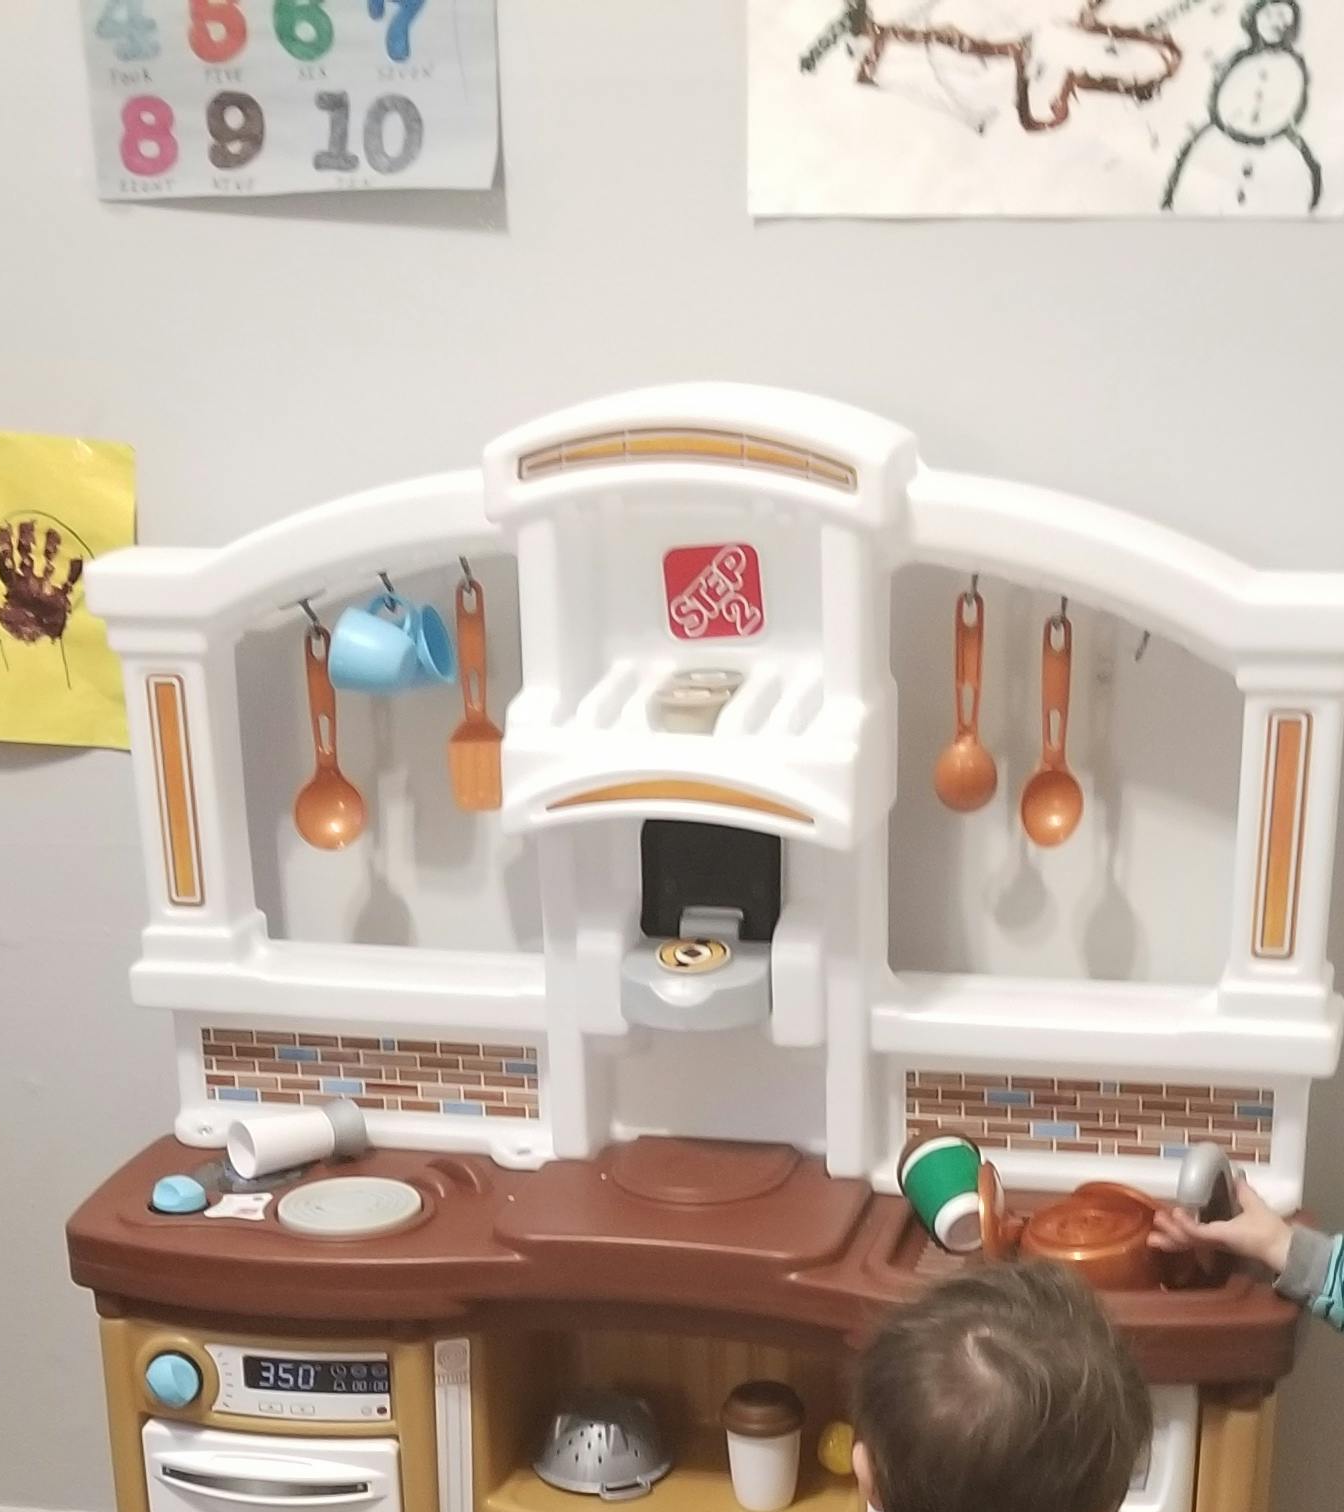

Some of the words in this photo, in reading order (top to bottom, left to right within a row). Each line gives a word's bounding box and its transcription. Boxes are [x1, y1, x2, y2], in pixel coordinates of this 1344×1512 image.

[272, 0, 334, 62] 6
[367, 0, 427, 62] 7
[120, 95, 179, 177] 8
[207, 90, 265, 170] 9
[312, 89, 424, 175] 10
[670, 545, 747, 638] STEP
[721, 592, 762, 637] 2
